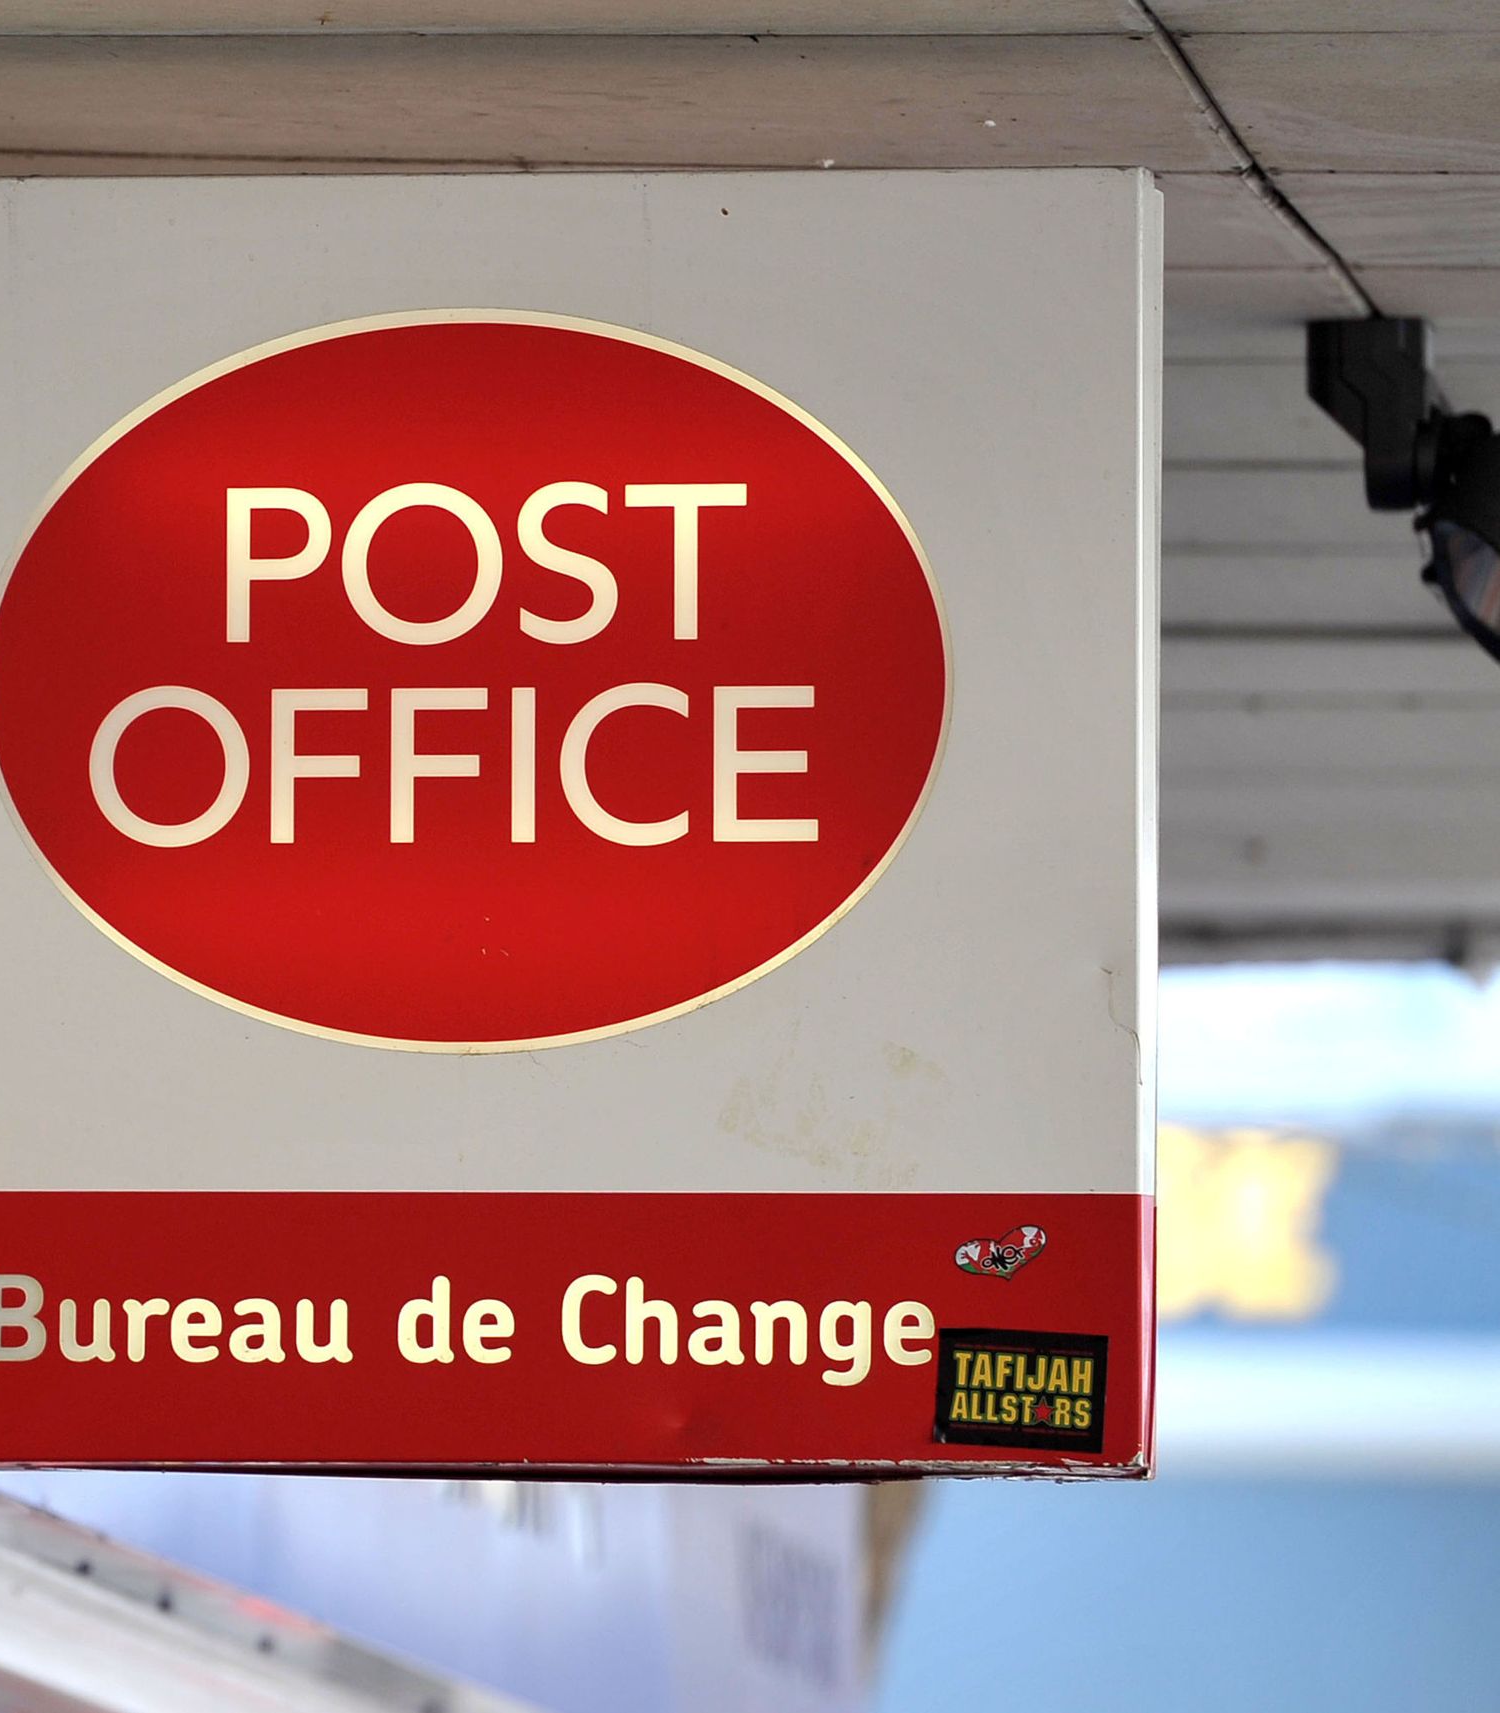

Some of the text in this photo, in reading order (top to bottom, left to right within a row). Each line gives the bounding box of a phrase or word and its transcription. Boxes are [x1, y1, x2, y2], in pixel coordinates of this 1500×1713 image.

[225, 481, 748, 646] POST
[88, 683, 820, 848] OFFICE
[397, 1275, 515, 1364] de
[560, 1274, 936, 1387] Change
[953, 1351, 1094, 1395] TAFIJAH
